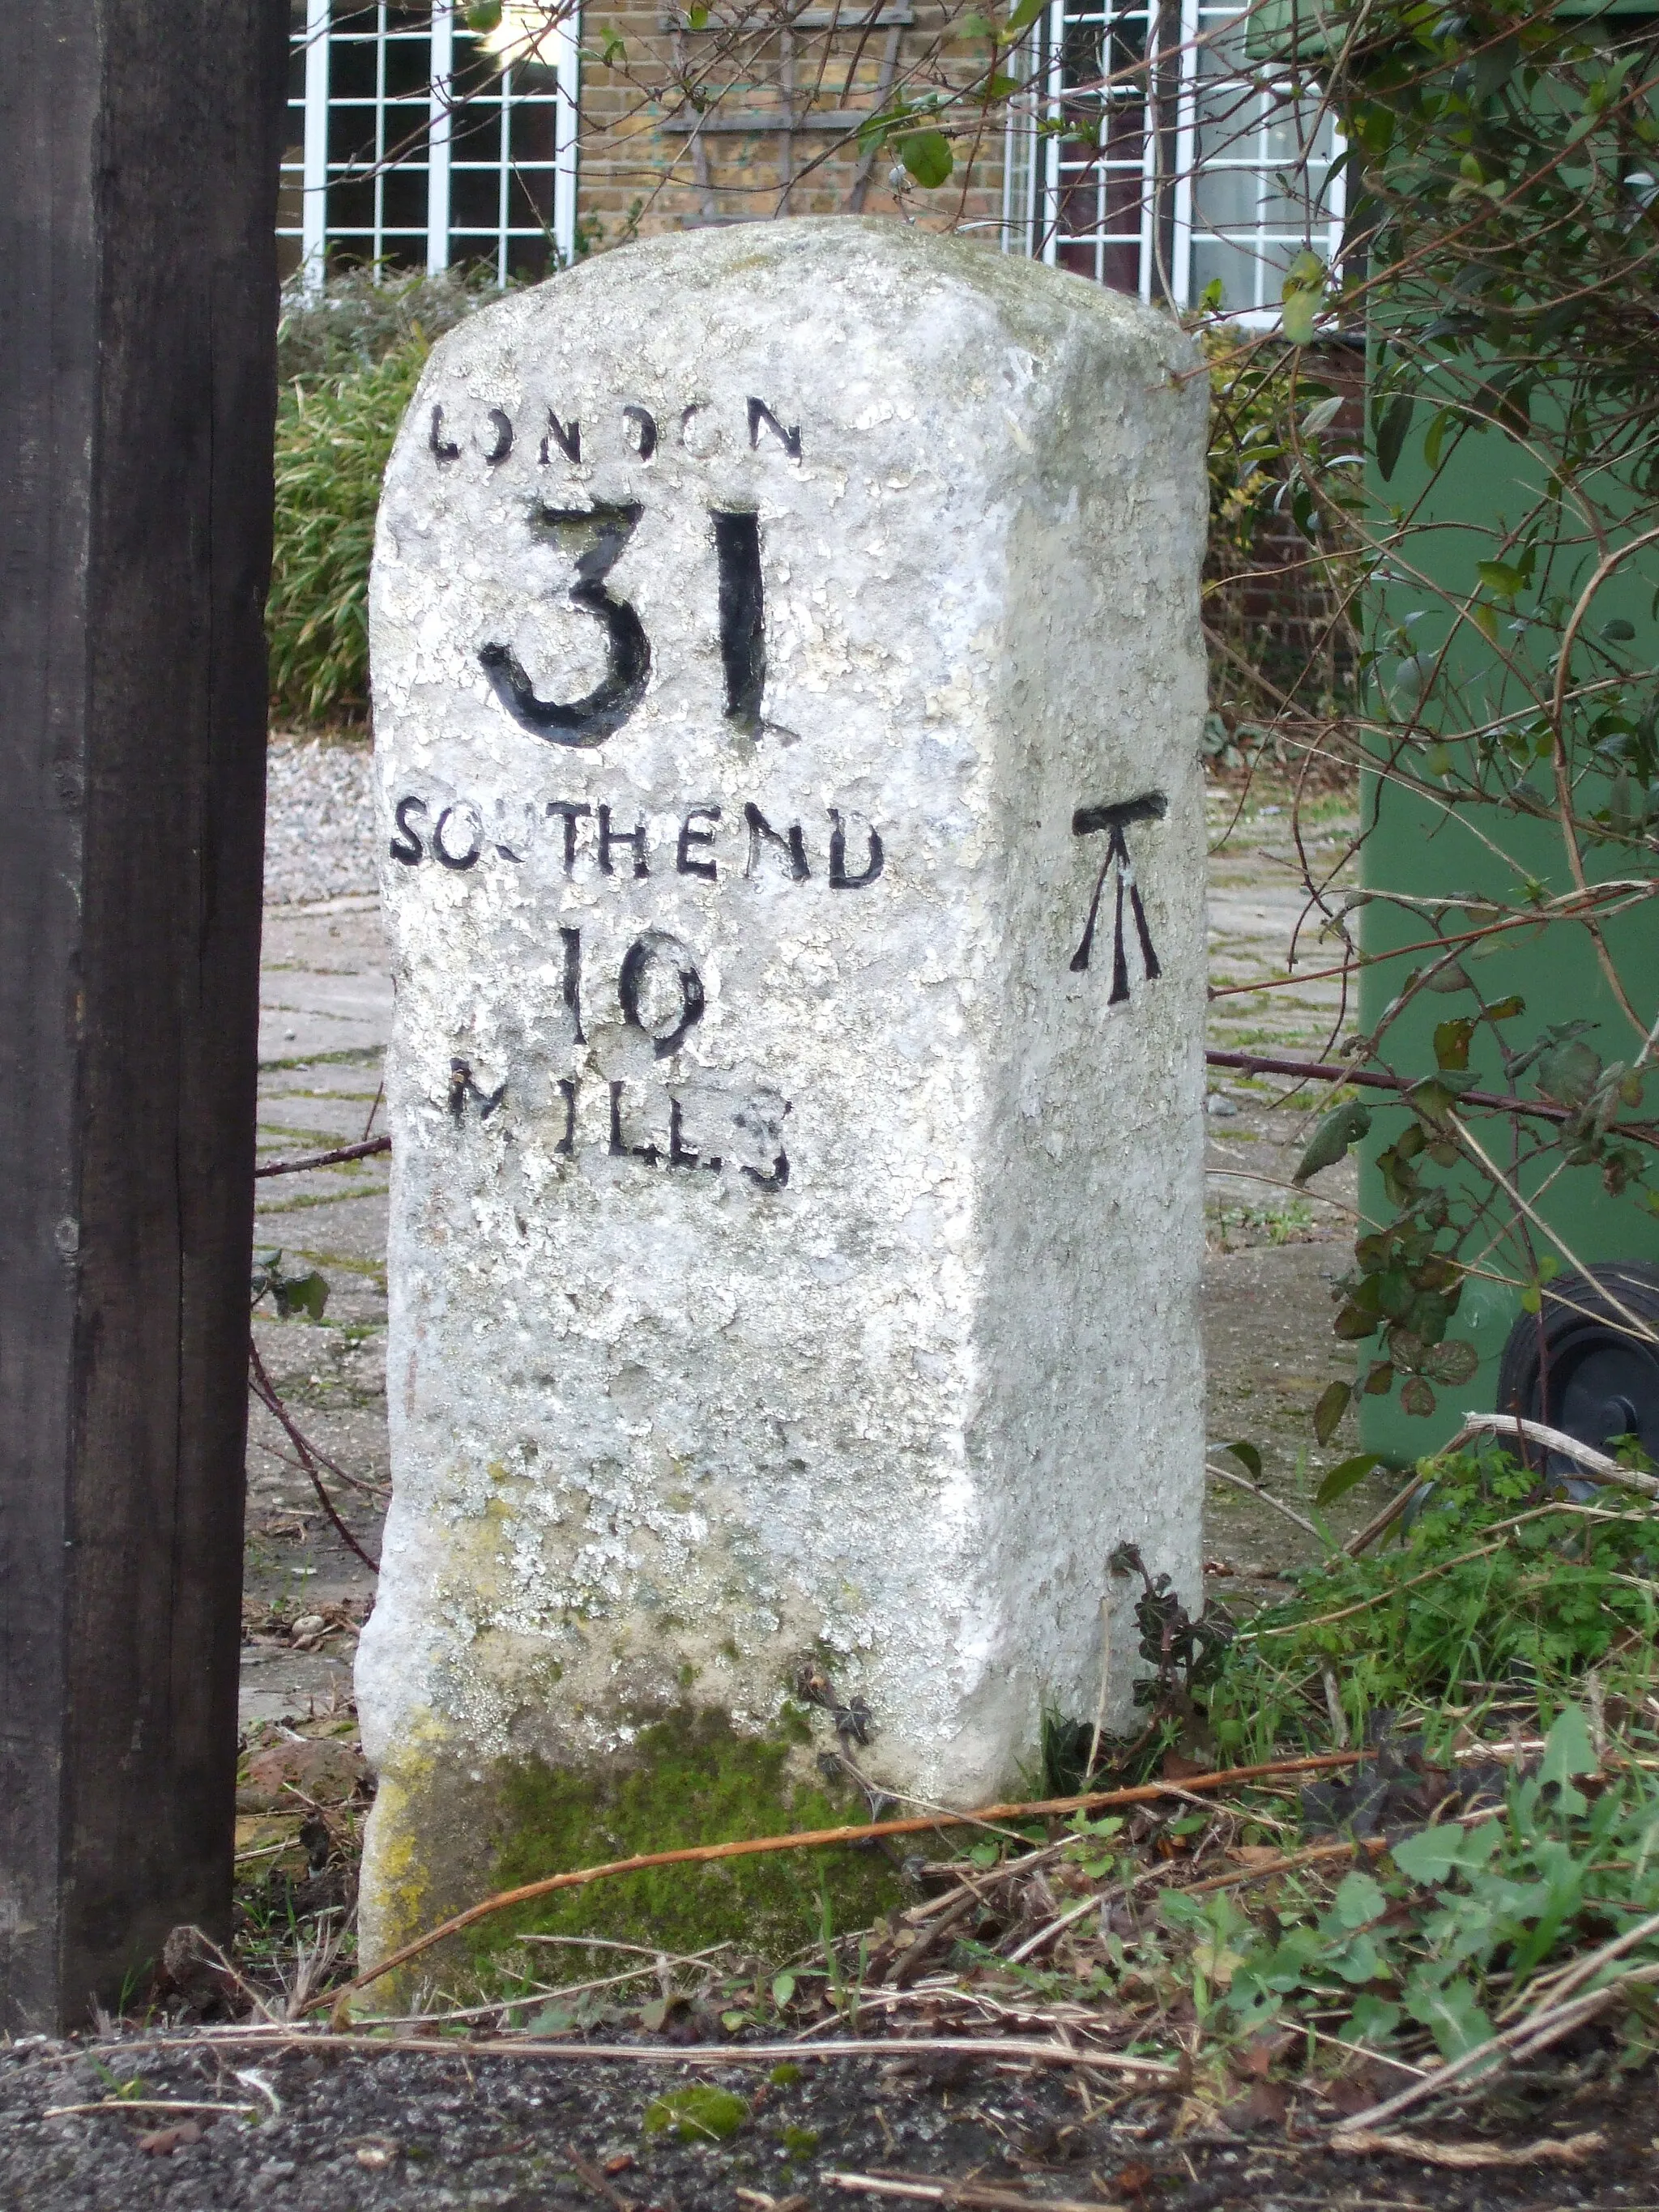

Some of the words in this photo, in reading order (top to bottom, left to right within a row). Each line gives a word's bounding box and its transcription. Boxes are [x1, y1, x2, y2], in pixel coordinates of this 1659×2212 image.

[431, 395, 804, 467] LONDON
[477, 497, 783, 749] 31
[559, 927, 705, 1061] 10
